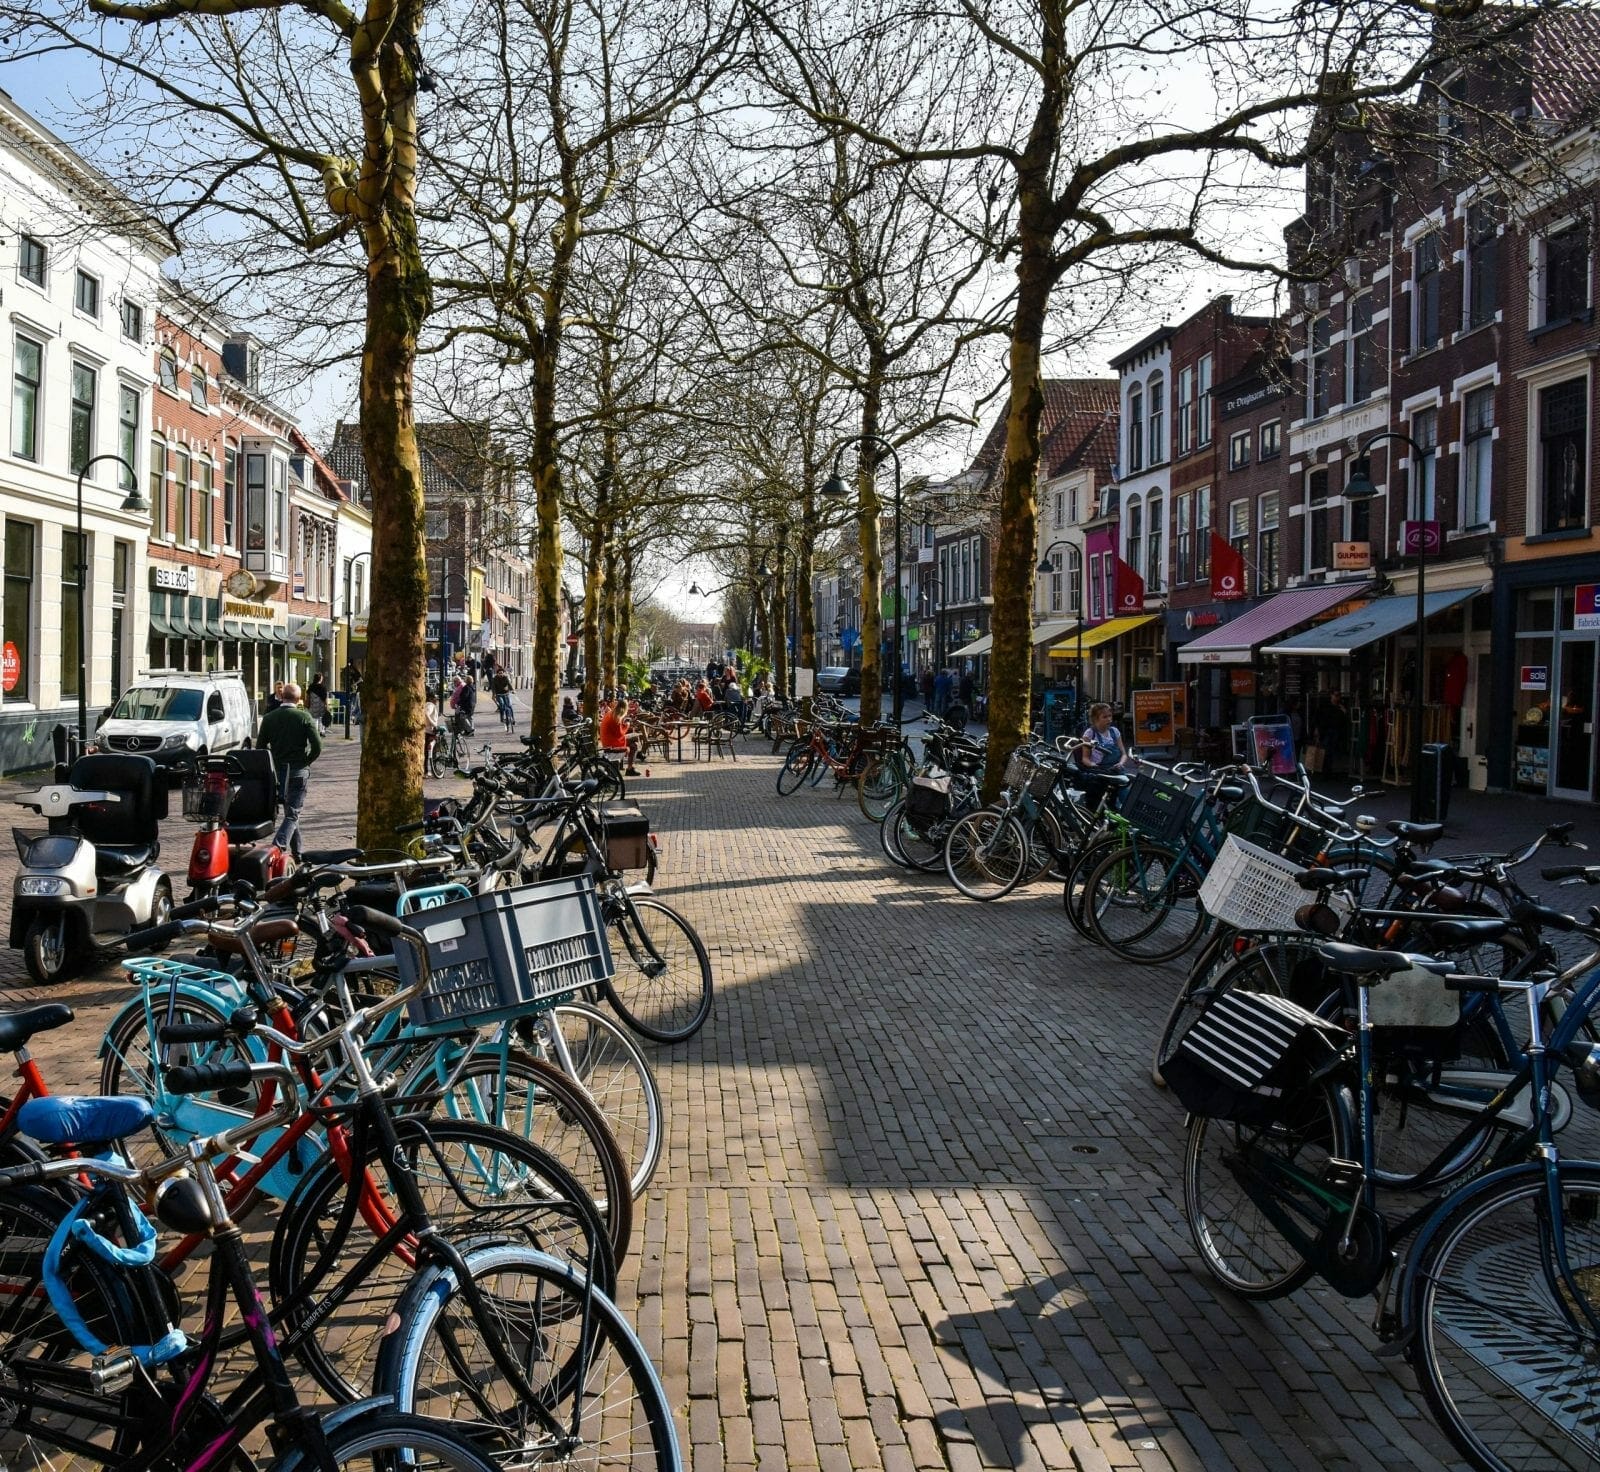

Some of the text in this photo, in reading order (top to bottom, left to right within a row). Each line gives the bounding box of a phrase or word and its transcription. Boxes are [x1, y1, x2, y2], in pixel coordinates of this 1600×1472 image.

[1337, 552, 1369, 560] GULPENER
[157, 569, 187, 587] SEIKO
[18, 1203, 33, 1213] CST
[301, 1298, 332, 1331] SWAPFIETS
